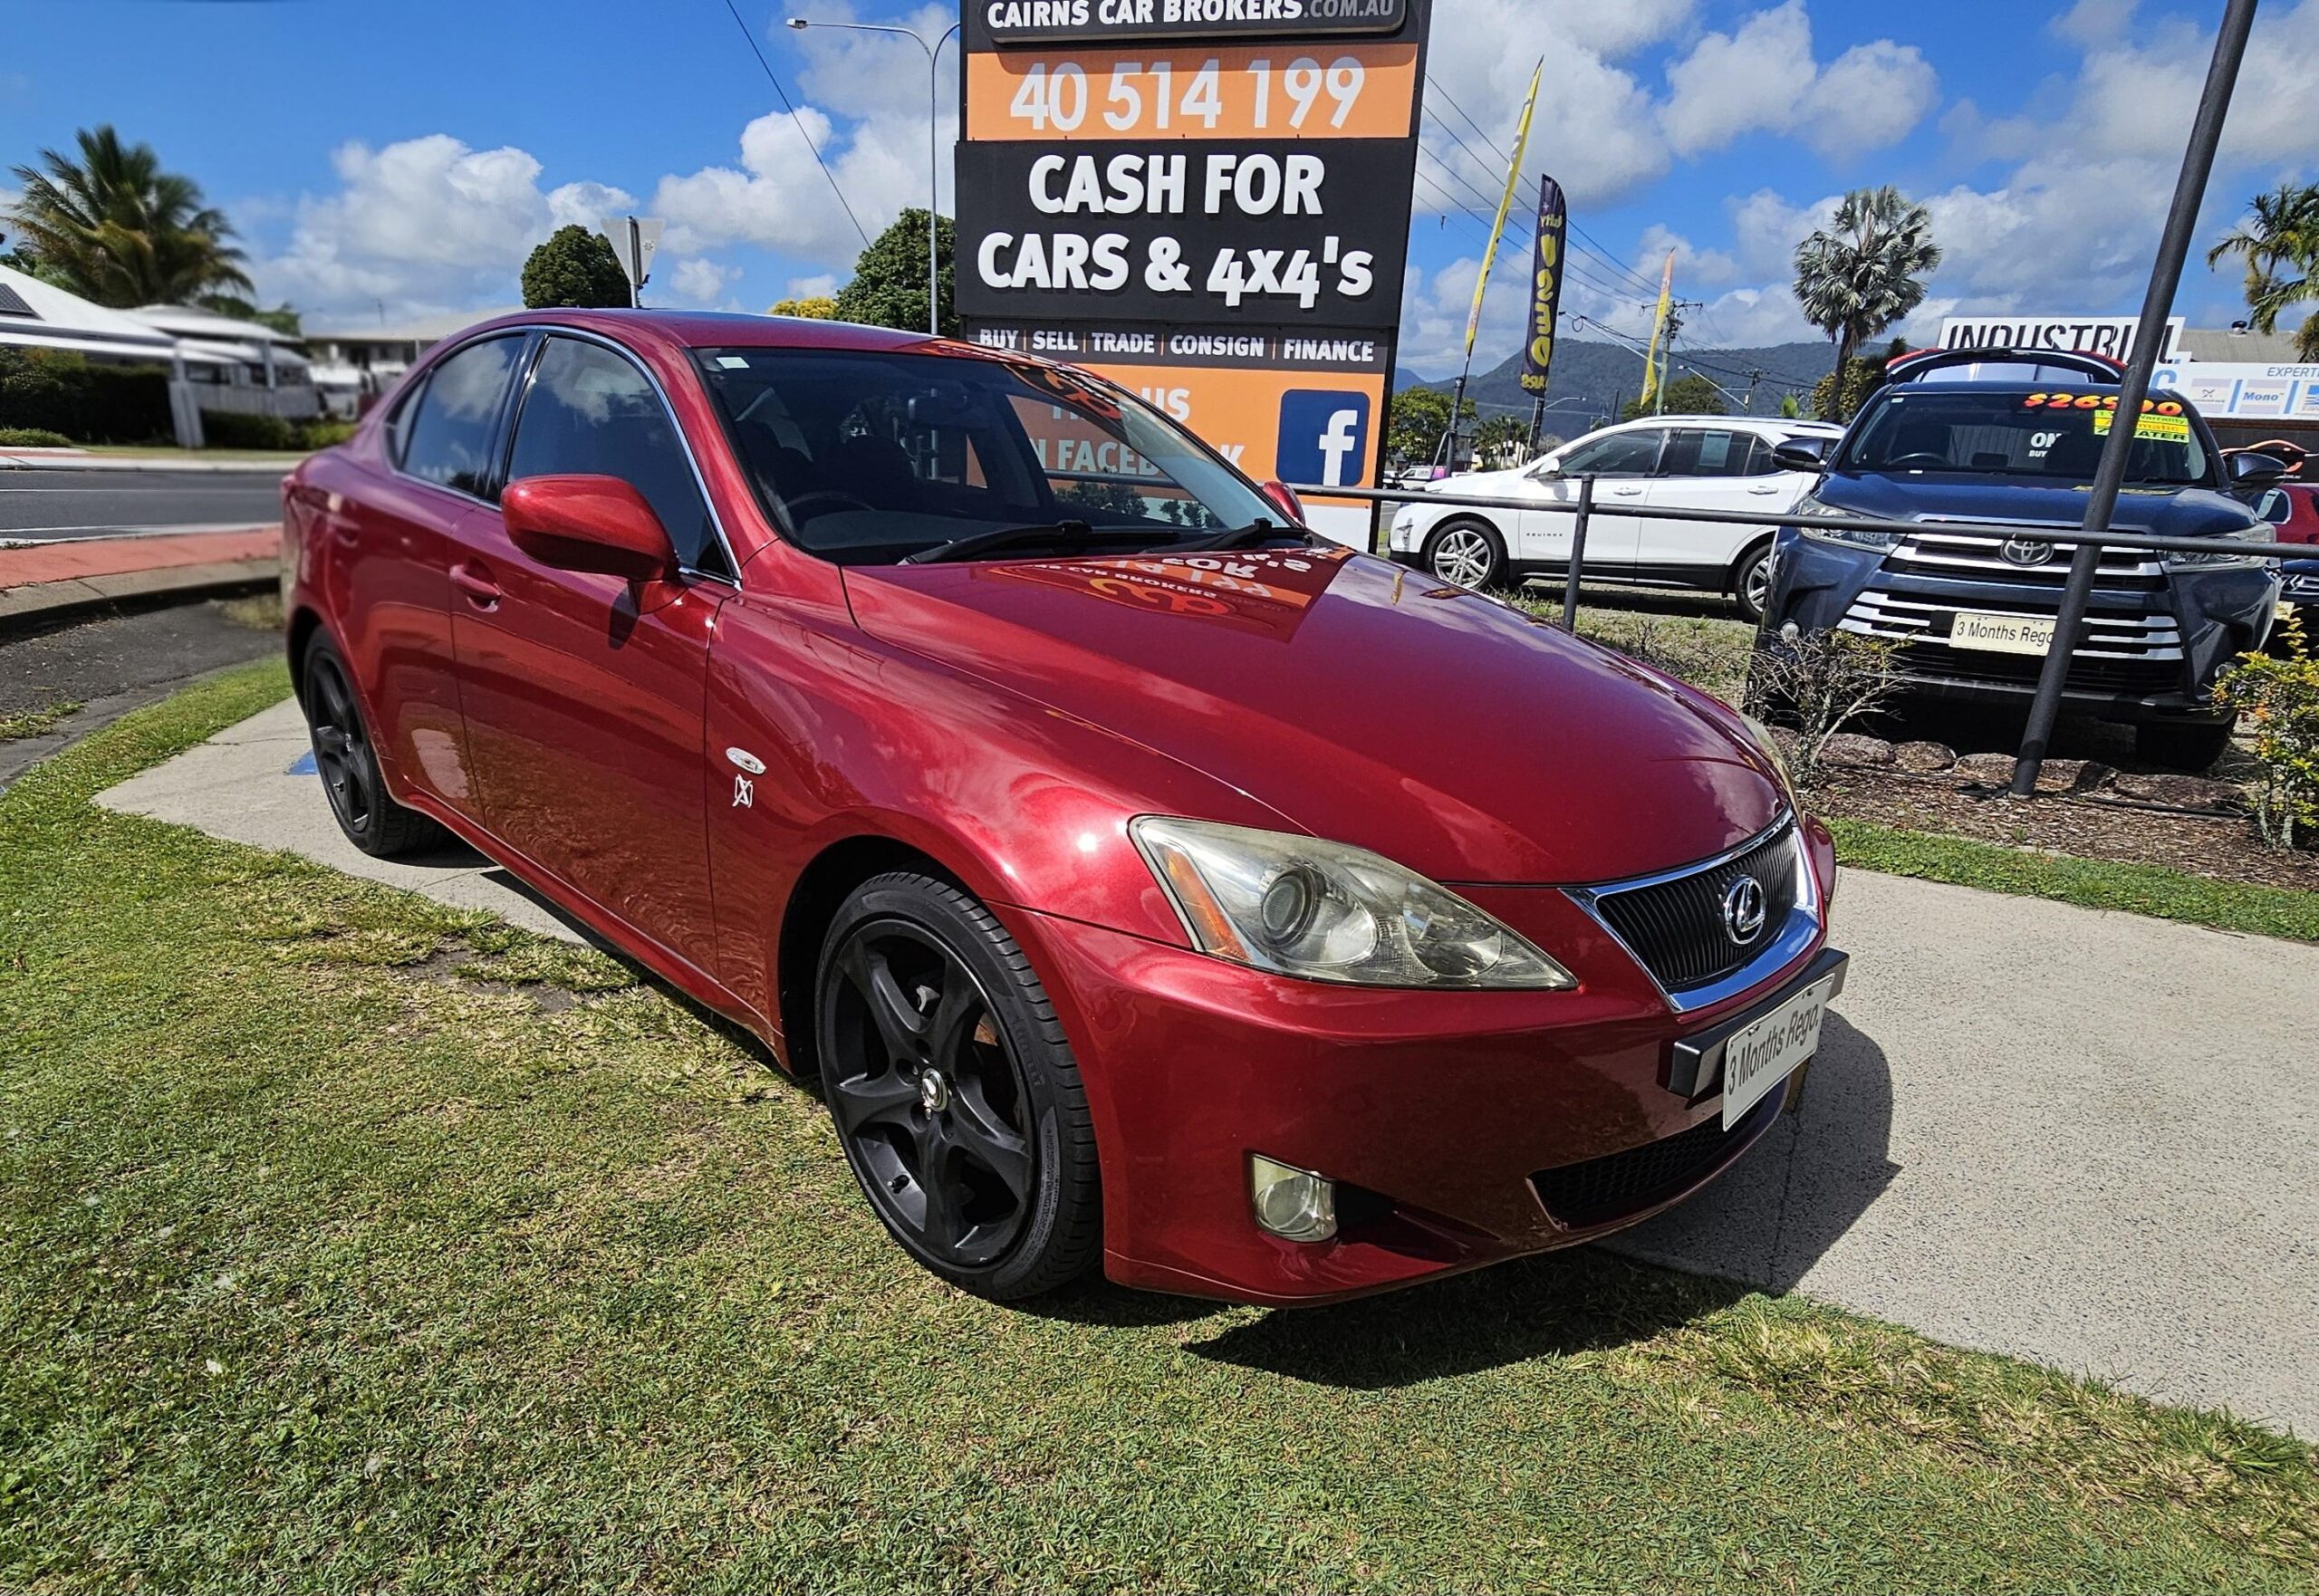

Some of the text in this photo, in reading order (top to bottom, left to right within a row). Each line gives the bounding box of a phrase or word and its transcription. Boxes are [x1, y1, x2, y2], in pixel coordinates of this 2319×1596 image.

[987, 0, 1090, 28] CAIRNS
[1099, 0, 1154, 24] CAR
[1010, 56, 1365, 131] 40 514 199
[1028, 153, 1325, 215] CASH FOR
[977, 232, 1130, 290] CARS
[1144, 236, 1191, 292] &
[979, 329, 1019, 349] BUY
[1032, 331, 1078, 351] SELL
[1092, 332, 1155, 353] TRADE
[1170, 335, 1265, 357] CONSIGN
[1284, 339, 1374, 361] FINANCE
[1948, 324, 2175, 364] INDUSTRIL
[2138, 430, 2185, 440] ATER
[1058, 439, 1246, 476] FACEBK
[1957, 621, 1966, 636] 3
[1968, 622, 2016, 640] Months
[1728, 1055, 1737, 1096] 3
[1739, 1026, 1785, 1087] Months
